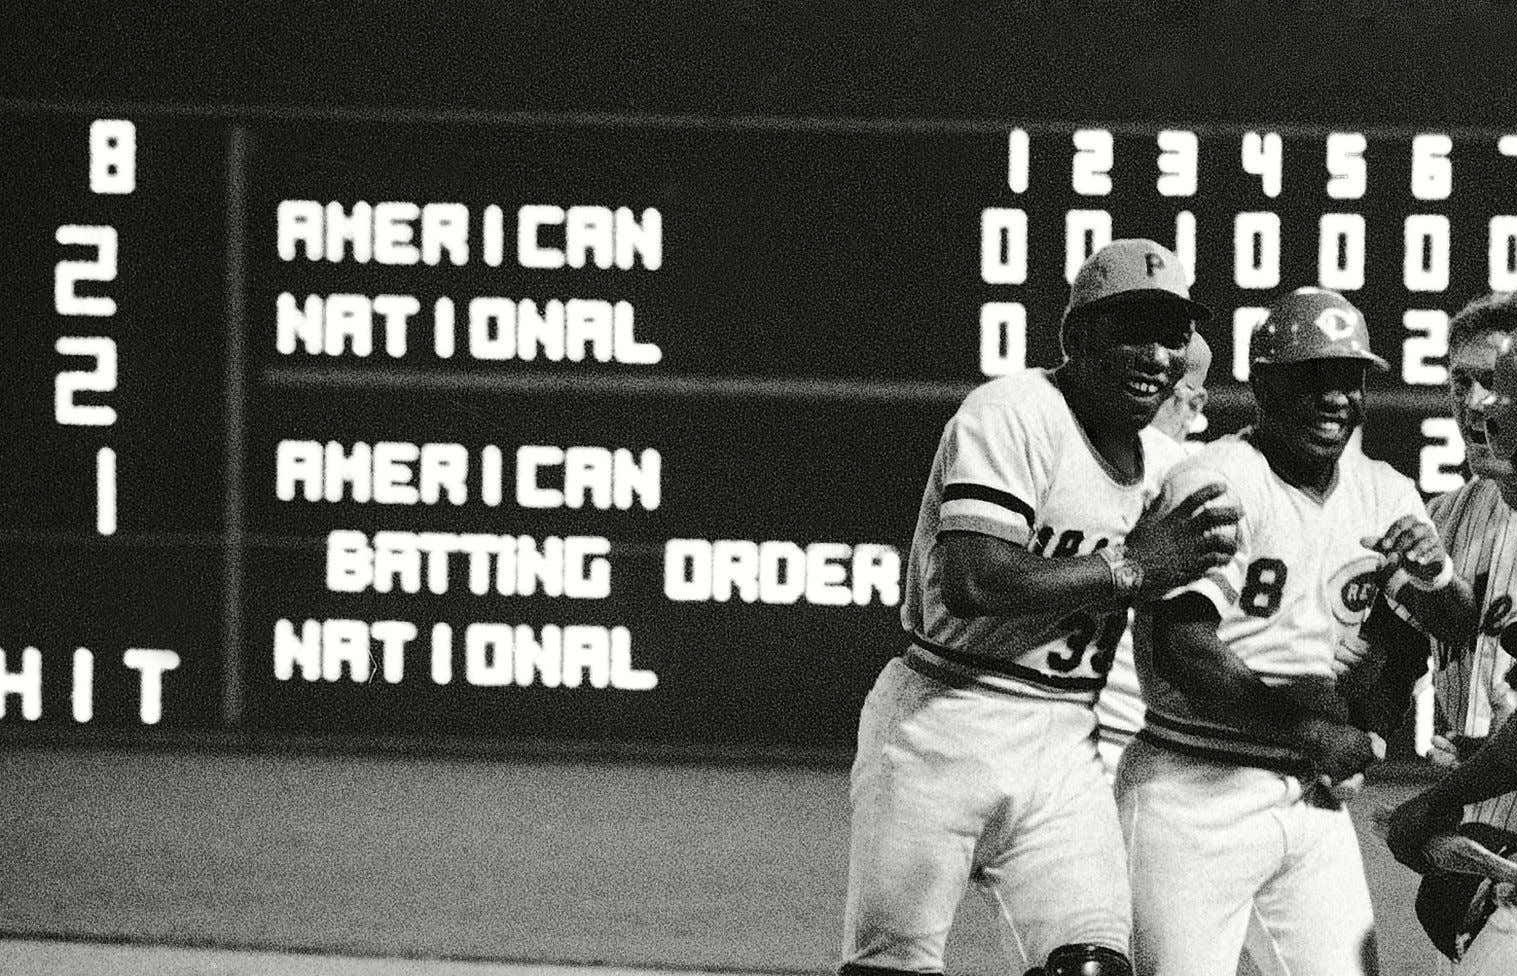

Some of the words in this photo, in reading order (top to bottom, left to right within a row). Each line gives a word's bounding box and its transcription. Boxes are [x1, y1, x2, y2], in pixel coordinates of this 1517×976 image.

[90, 120, 136, 194] 8
[1009, 128, 1029, 193] 1
[1072, 129, 1113, 195] 2
[1157, 129, 1198, 196] 3
[1242, 131, 1282, 197] 4
[1327, 132, 1367, 199] 5
[1411, 133, 1452, 200] 6
[55, 225, 117, 316] 2
[277, 200, 662, 270] AMERICAN
[981, 208, 1028, 284] 0
[1234, 212, 1280, 289] 0
[1319, 213, 1366, 290] 0
[1404, 214, 1450, 291] 0
[1145, 253, 1165, 277] P
[277, 292, 662, 364] NATIONAL
[981, 302, 1027, 376] 0
[1402, 310, 1449, 385] 2
[55, 337, 117, 425] 2
[97, 447, 116, 535] 1
[276, 440, 661, 510] AMERICAN
[326, 530, 611, 599] BATTING
[664, 539, 901, 606] ORDER
[1239, 558, 1288, 618] 8
[0, 647, 180, 724] HIT
[274, 619, 658, 690] NATIONAL
